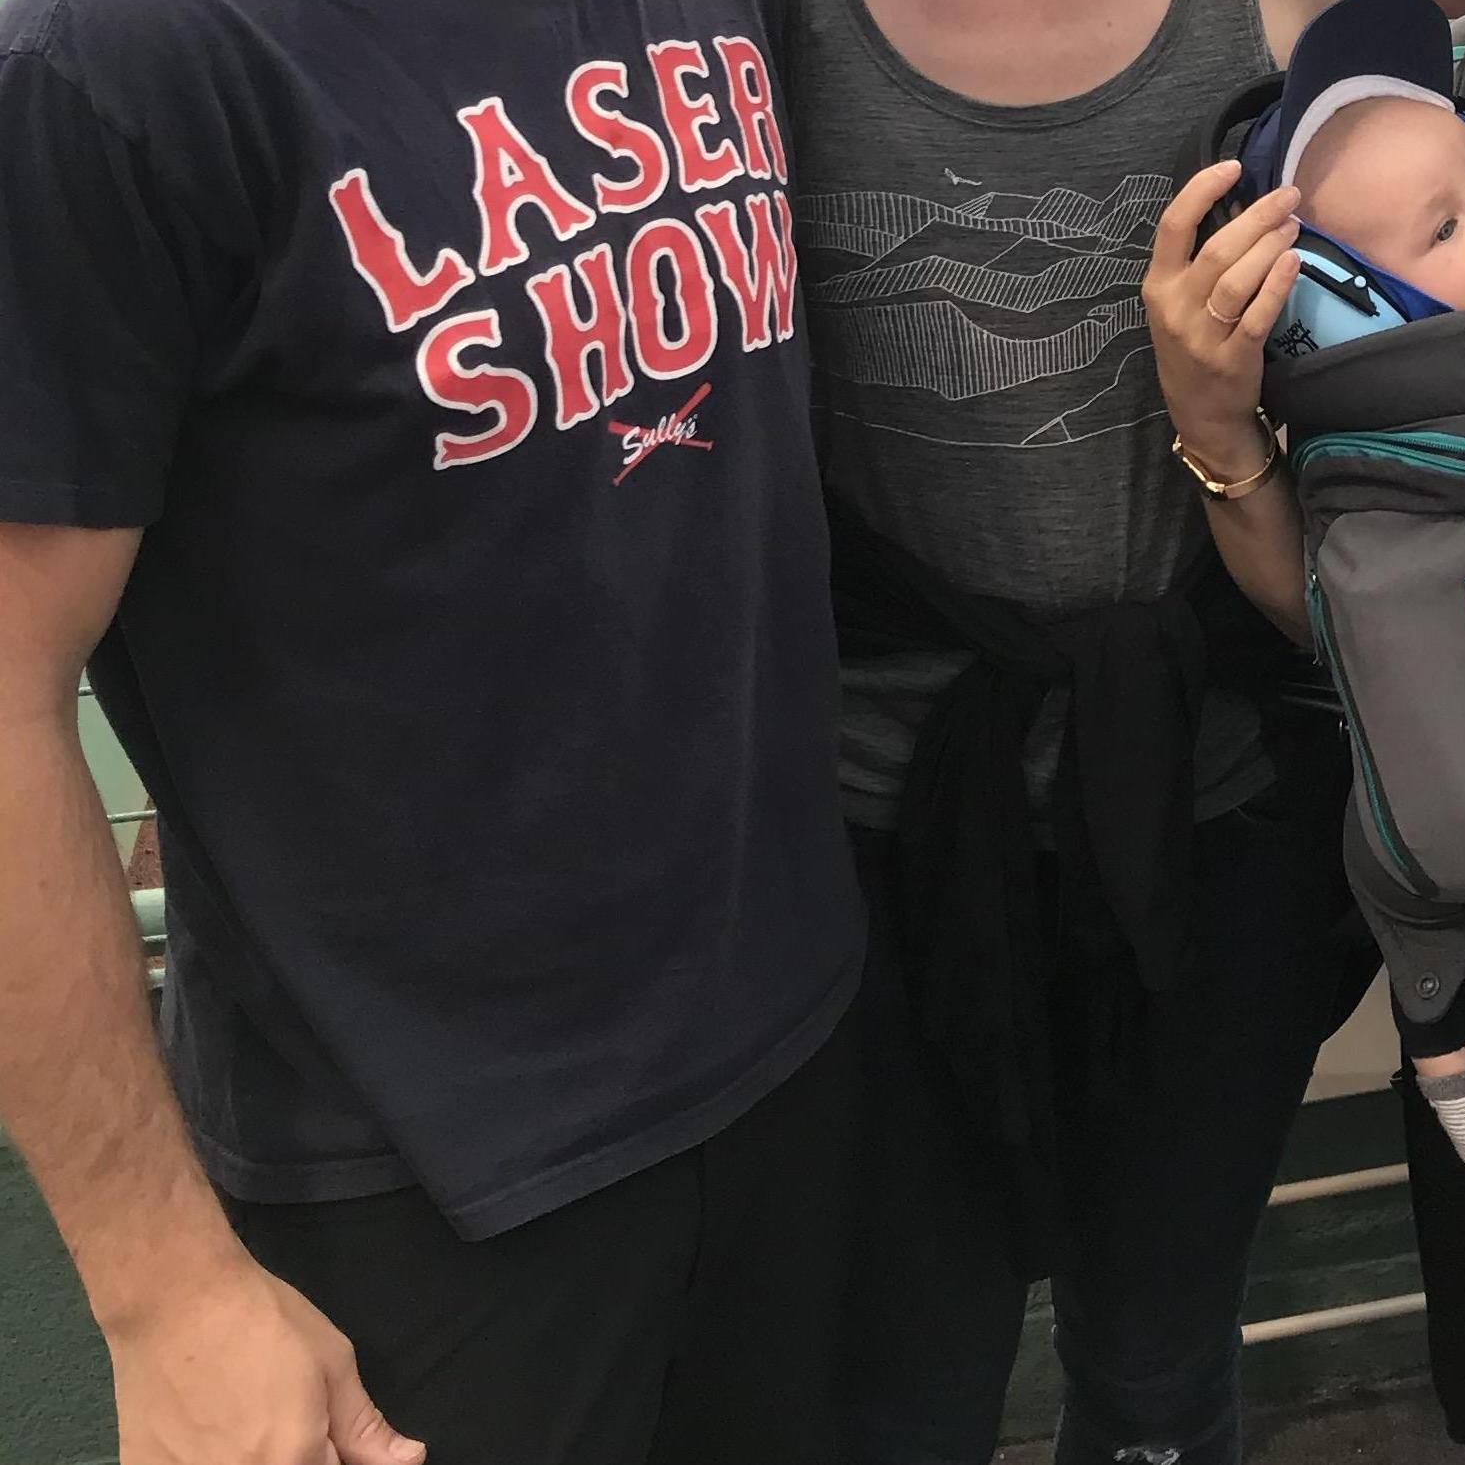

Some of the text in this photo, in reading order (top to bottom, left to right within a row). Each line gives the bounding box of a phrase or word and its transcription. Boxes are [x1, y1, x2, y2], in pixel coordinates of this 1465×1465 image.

[328, 35, 789, 334] LASER
[416, 189, 798, 471] SHOW
[622, 412, 699, 465] Sully's
